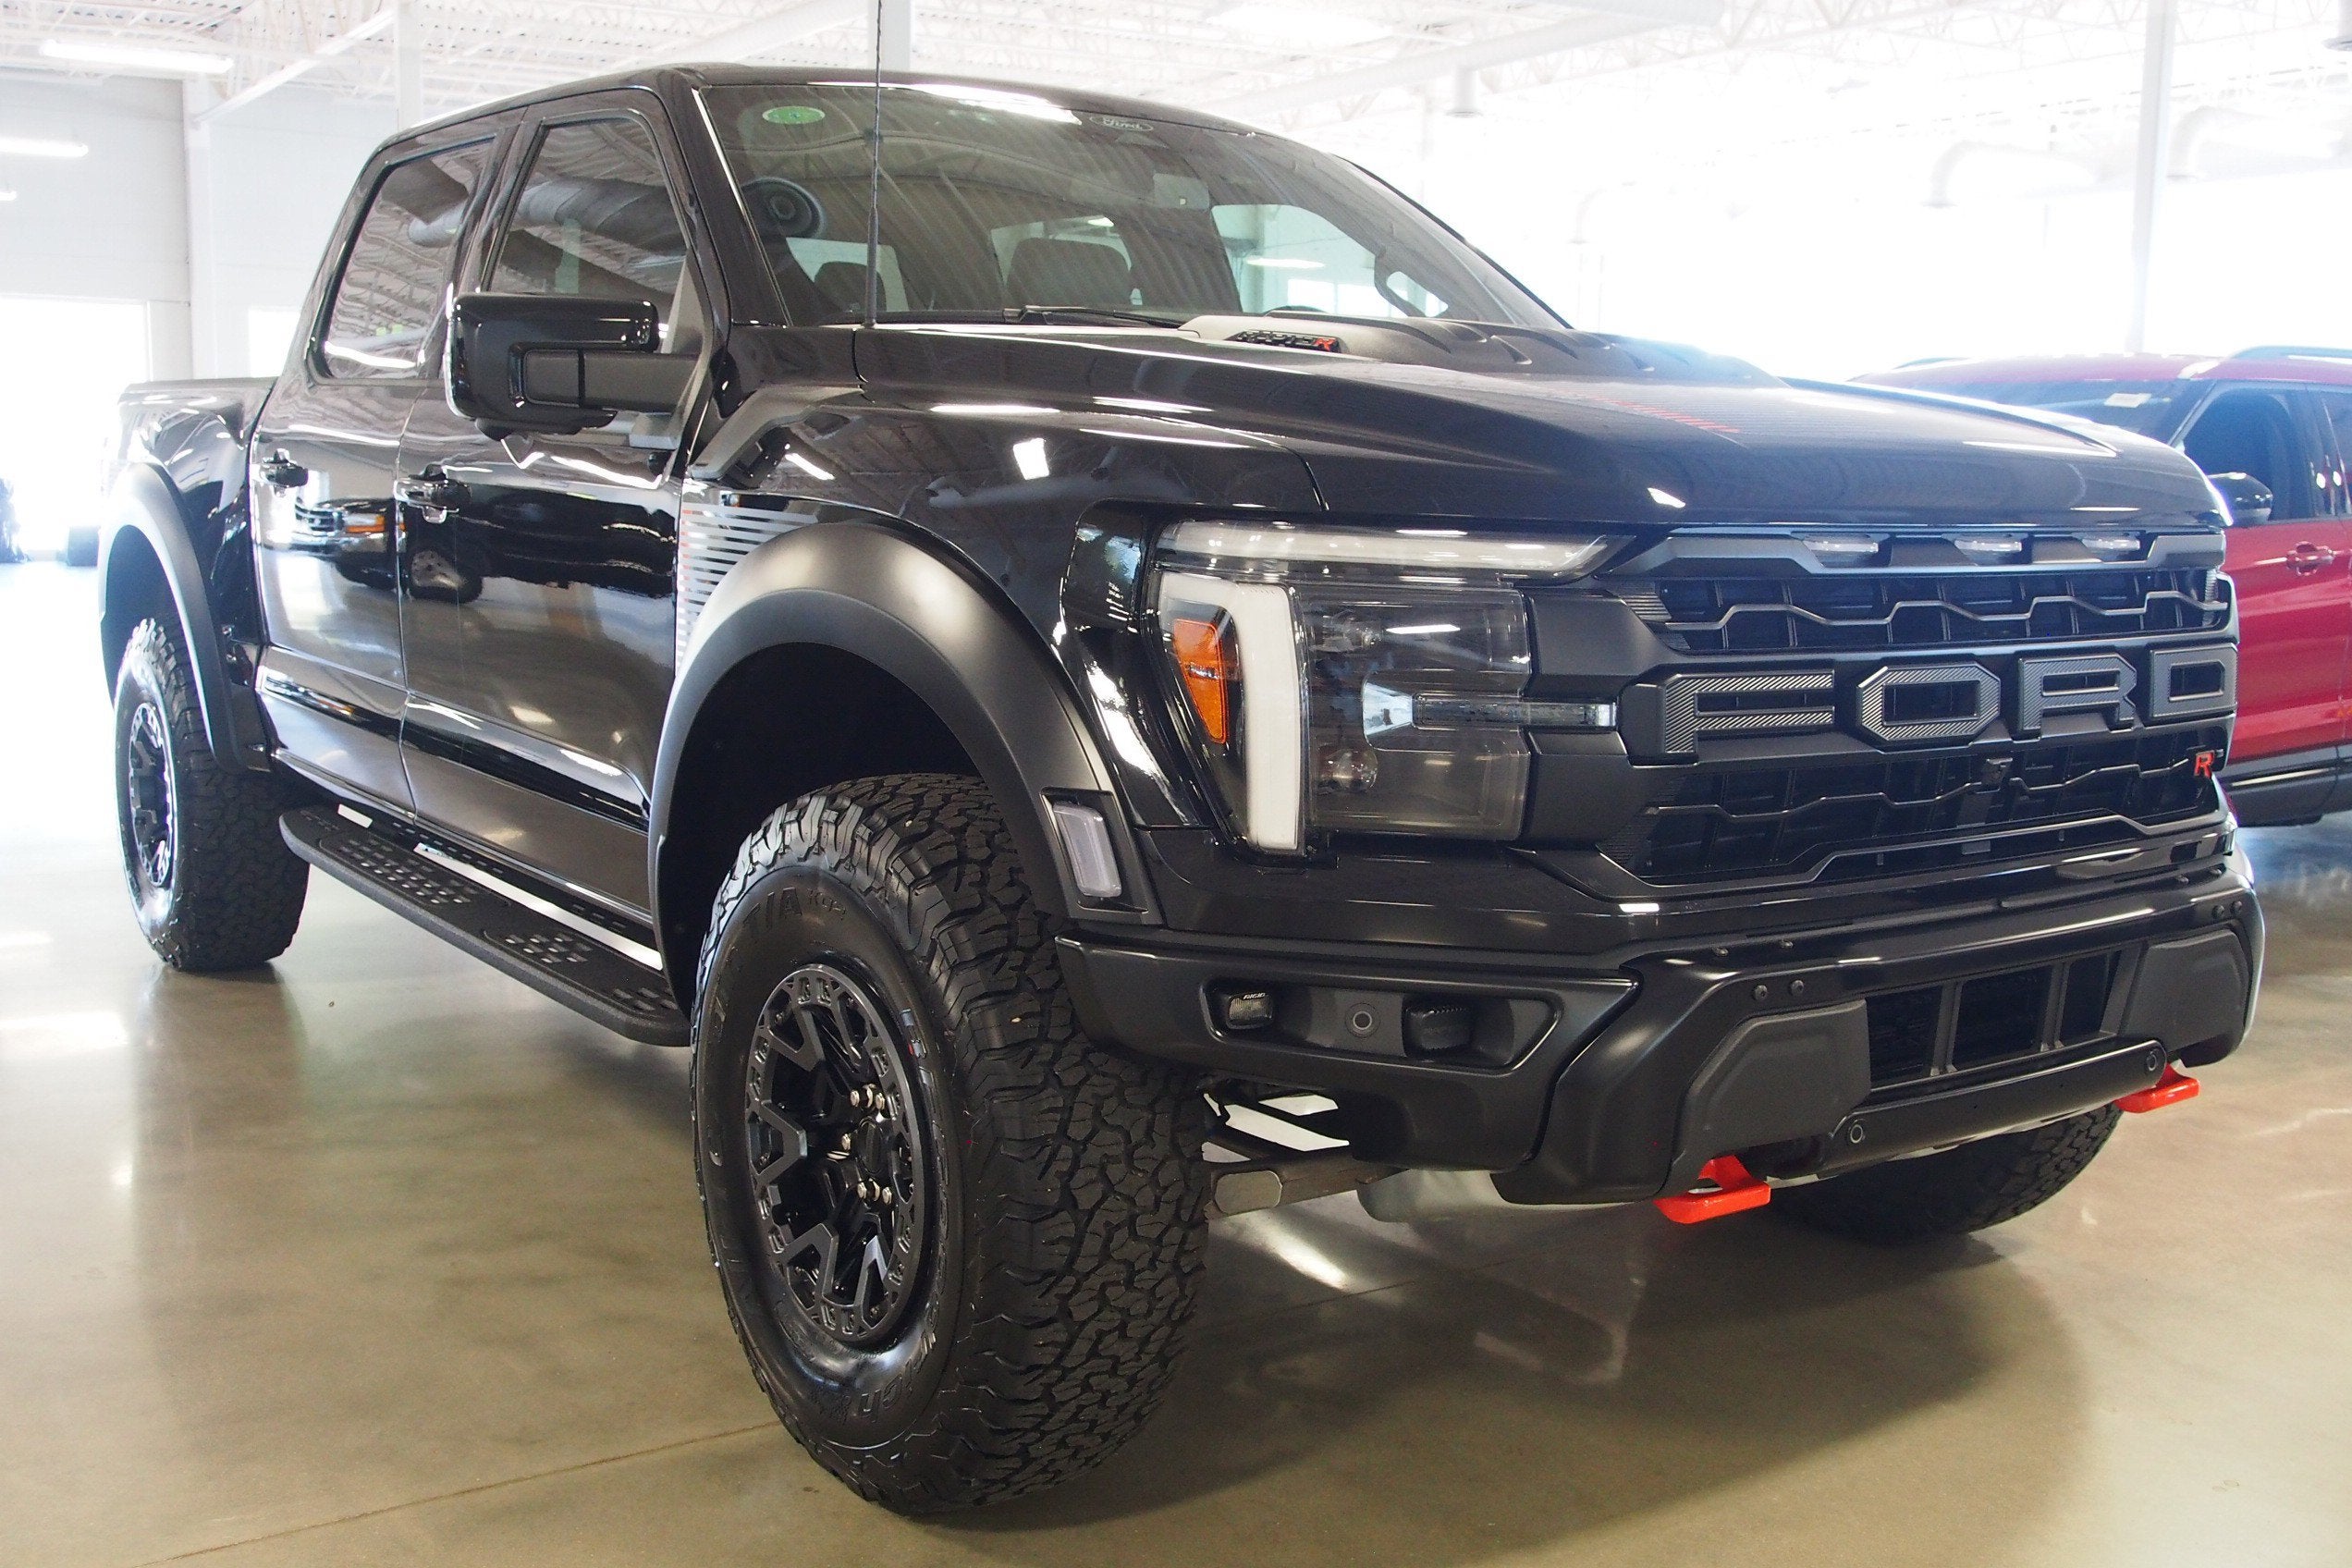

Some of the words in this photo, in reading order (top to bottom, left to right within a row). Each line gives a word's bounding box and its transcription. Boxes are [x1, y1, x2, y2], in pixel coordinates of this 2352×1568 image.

[1101, 116, 1144, 129] Ford
[1663, 643, 2236, 754] FORD
[2194, 750, 2215, 778] R
[1243, 992, 1267, 1000] RIGID
